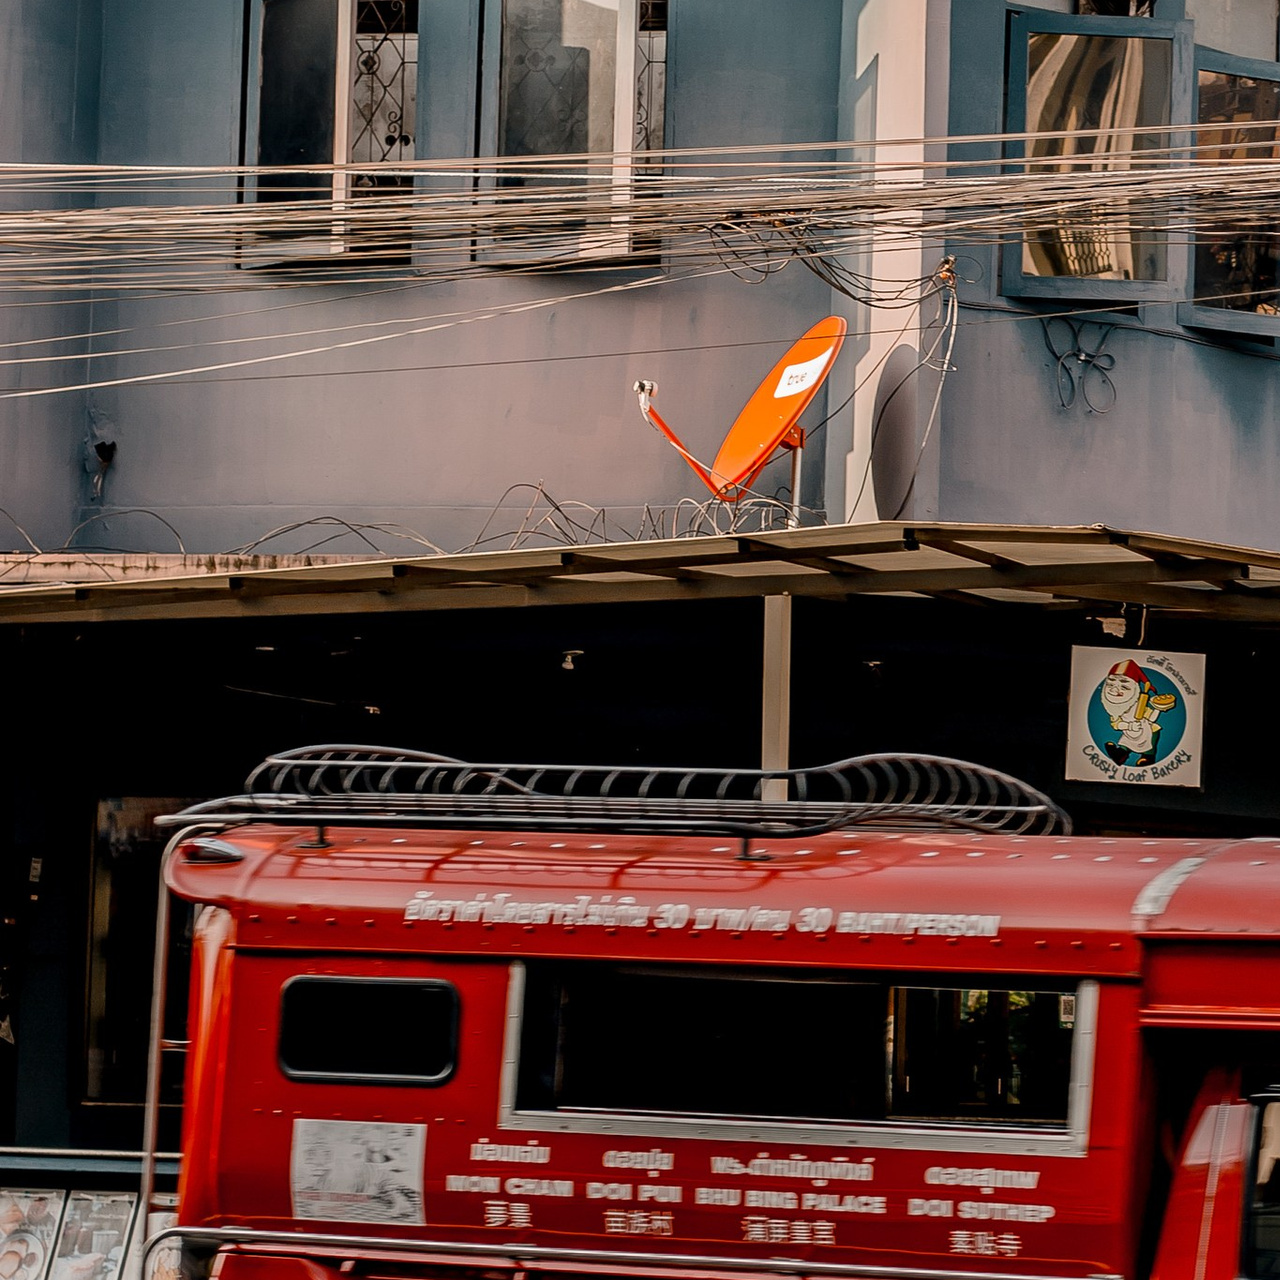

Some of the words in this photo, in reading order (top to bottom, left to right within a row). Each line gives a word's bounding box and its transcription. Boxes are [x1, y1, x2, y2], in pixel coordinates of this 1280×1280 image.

[653, 903, 691, 929] 30
[795, 907, 834, 933] 30
[801, 1193, 888, 1214] PALACE
